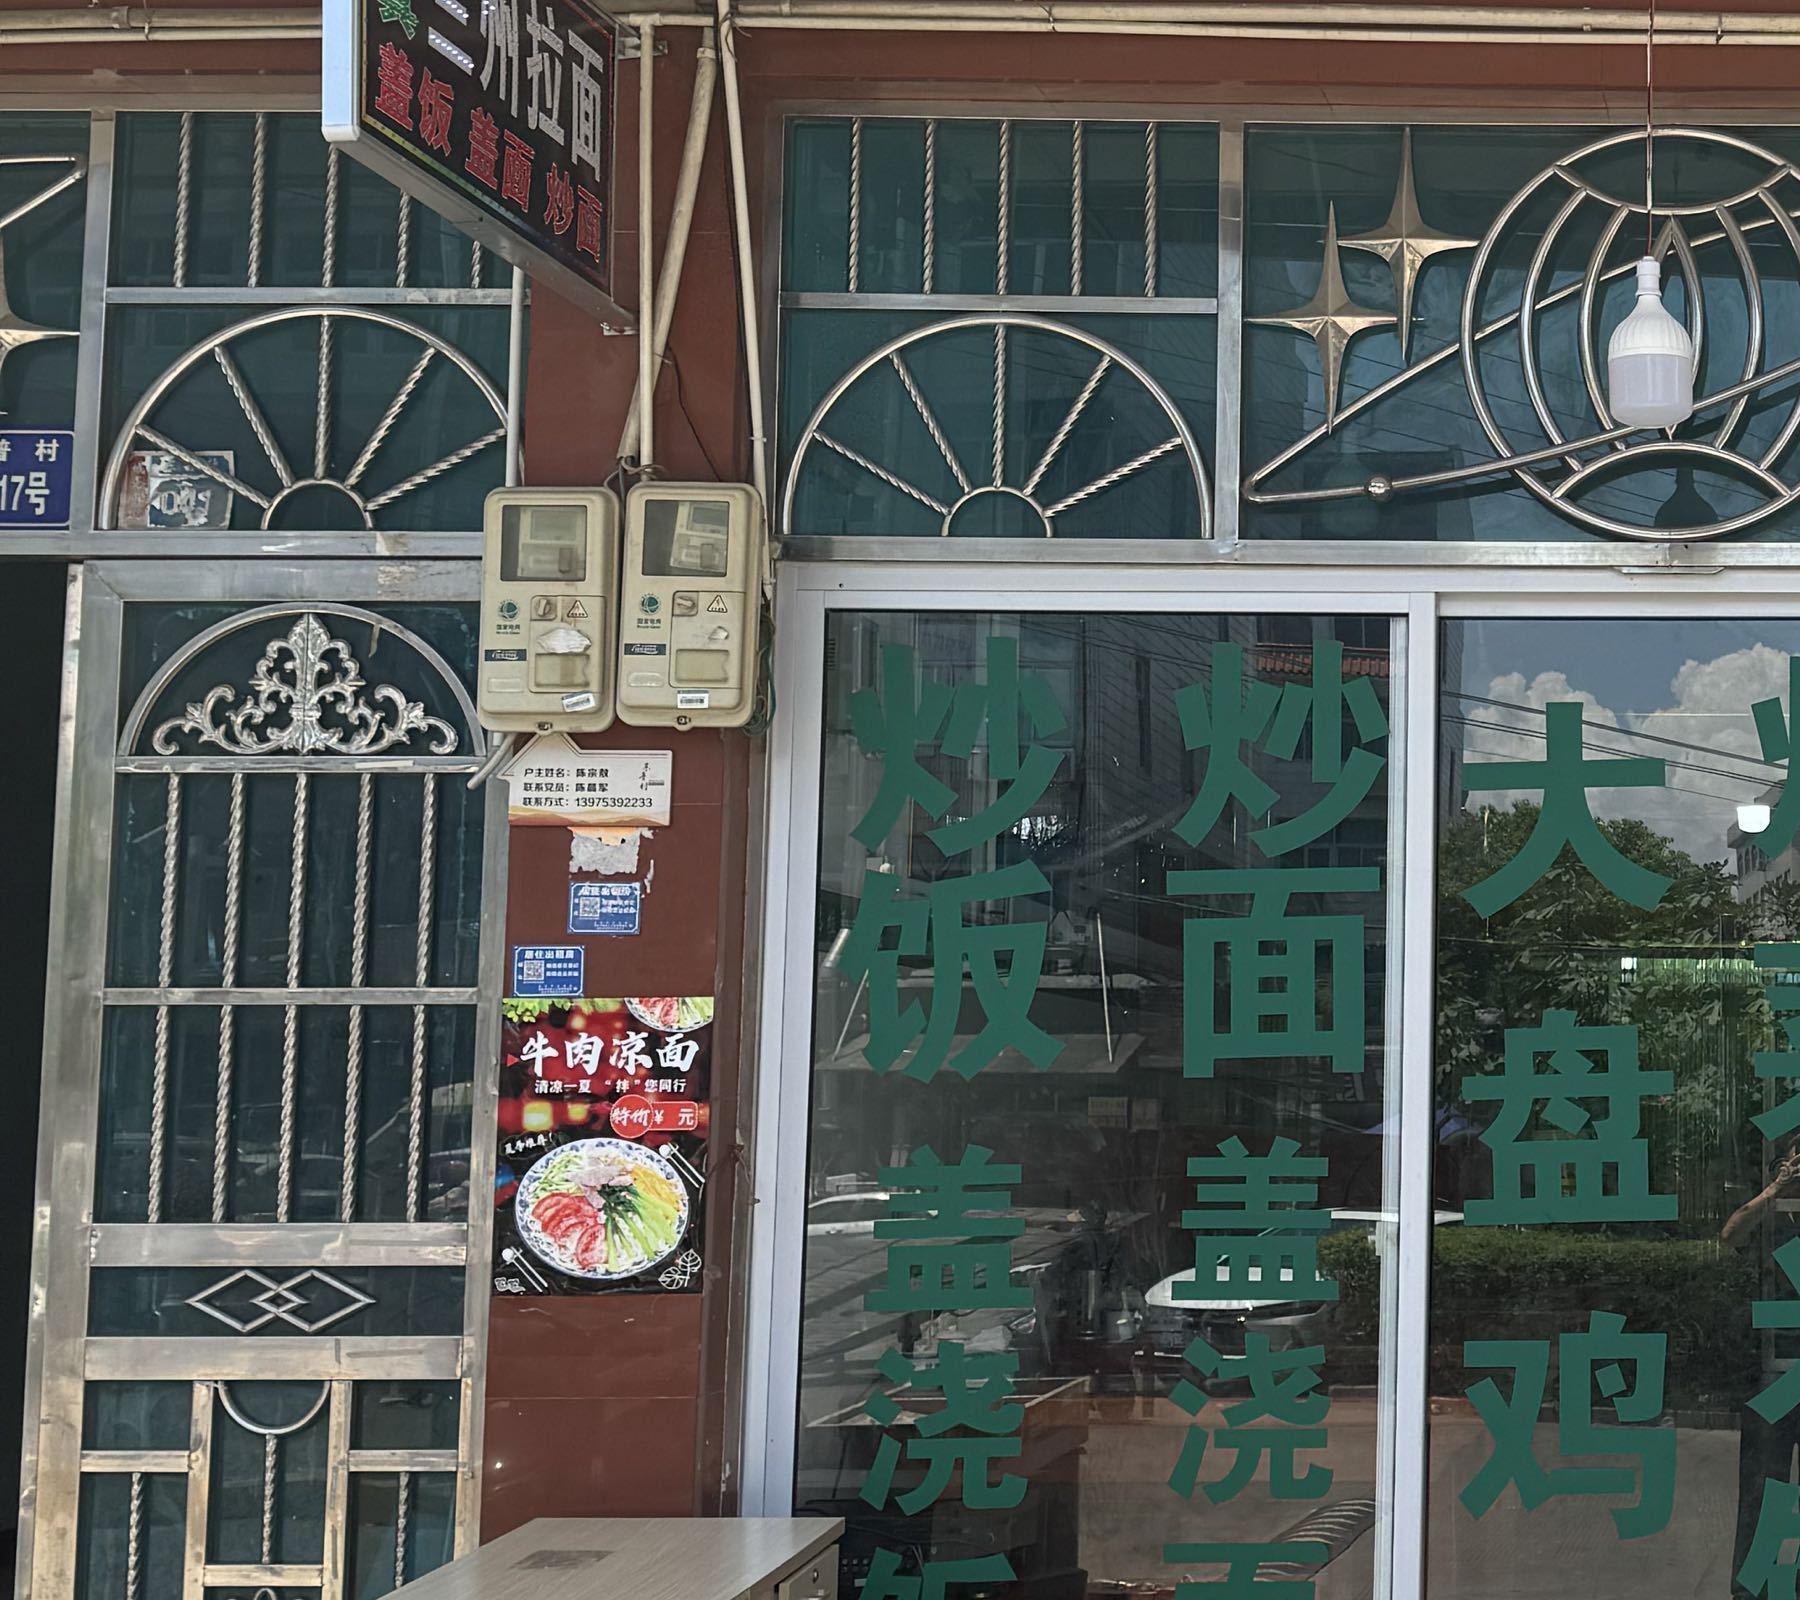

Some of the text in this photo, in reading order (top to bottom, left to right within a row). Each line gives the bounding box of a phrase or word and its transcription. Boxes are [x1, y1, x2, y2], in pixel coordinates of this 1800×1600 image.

[520, 1030, 701, 1077] 牛肉凉面
[1459, 700, 1679, 1541] 大盘鸡
